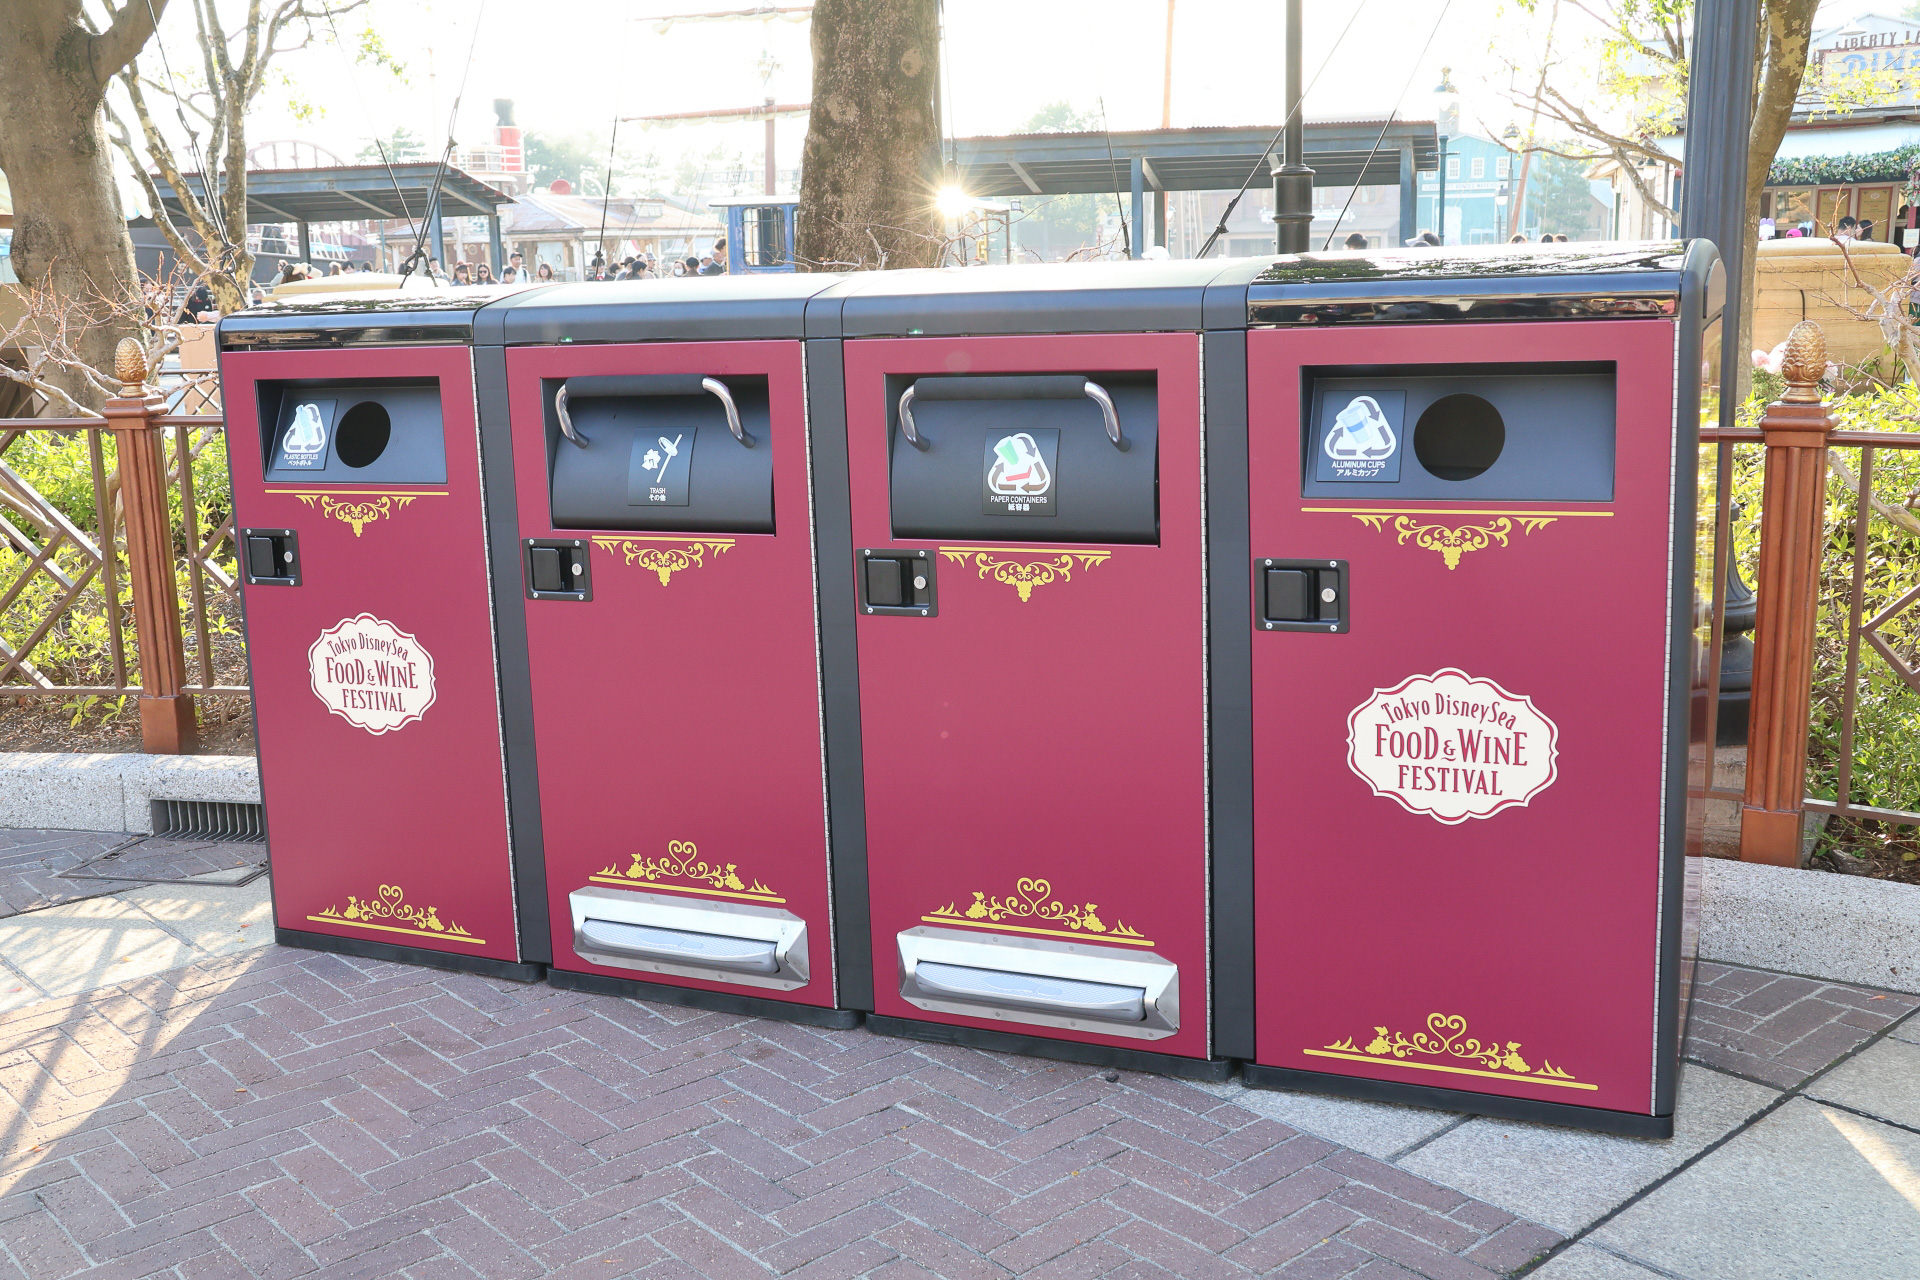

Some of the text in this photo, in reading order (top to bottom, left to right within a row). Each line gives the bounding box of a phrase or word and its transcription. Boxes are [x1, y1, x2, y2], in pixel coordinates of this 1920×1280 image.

[1835, 32, 1897, 50] LIBERTY
[1331, 460, 1386, 469] ALUMINUM CUPS
[1336, 468, 1380, 477] アルミカップ
[990, 495, 1048, 504] PAPER CONTAINERS
[327, 632, 409, 661] Tokyo DisneySea
[367, 668, 376, 686] &
[342, 688, 406, 713] FESTIVAL
[1381, 692, 1517, 731] Tokyo DisneySea
[1441, 739, 1456, 762] &
[1398, 764, 1503, 796] FESTIVAL
